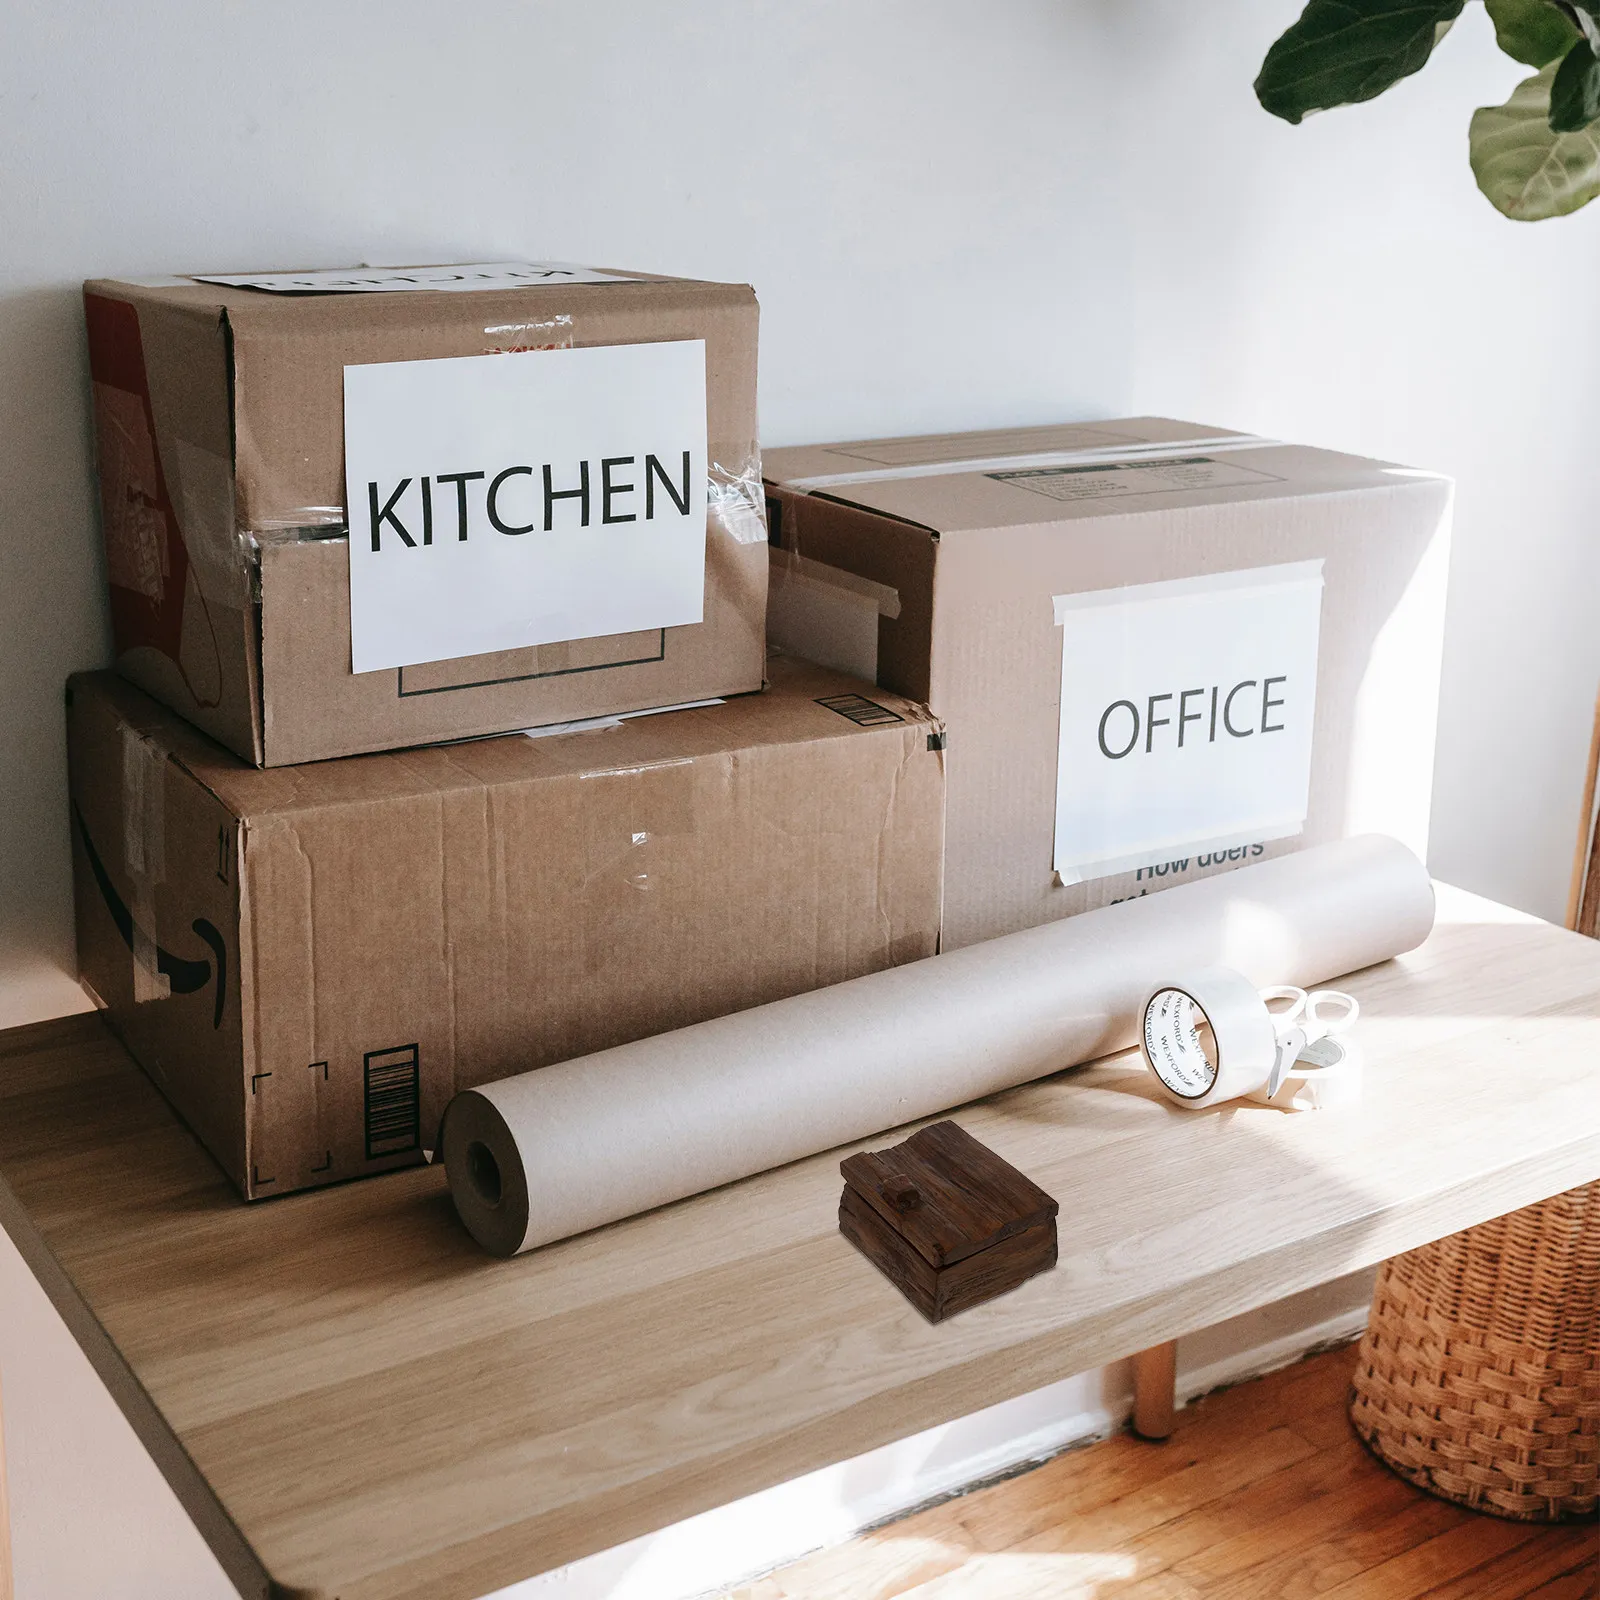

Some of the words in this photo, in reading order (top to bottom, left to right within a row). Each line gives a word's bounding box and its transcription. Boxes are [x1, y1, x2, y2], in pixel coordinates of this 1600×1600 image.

[368, 450, 690, 552] KITCHEN
[1098, 676, 1287, 760] OFFICE
[1173, 996, 1184, 1043] WEXFORD
[1161, 1036, 1188, 1081] WEXFORD
